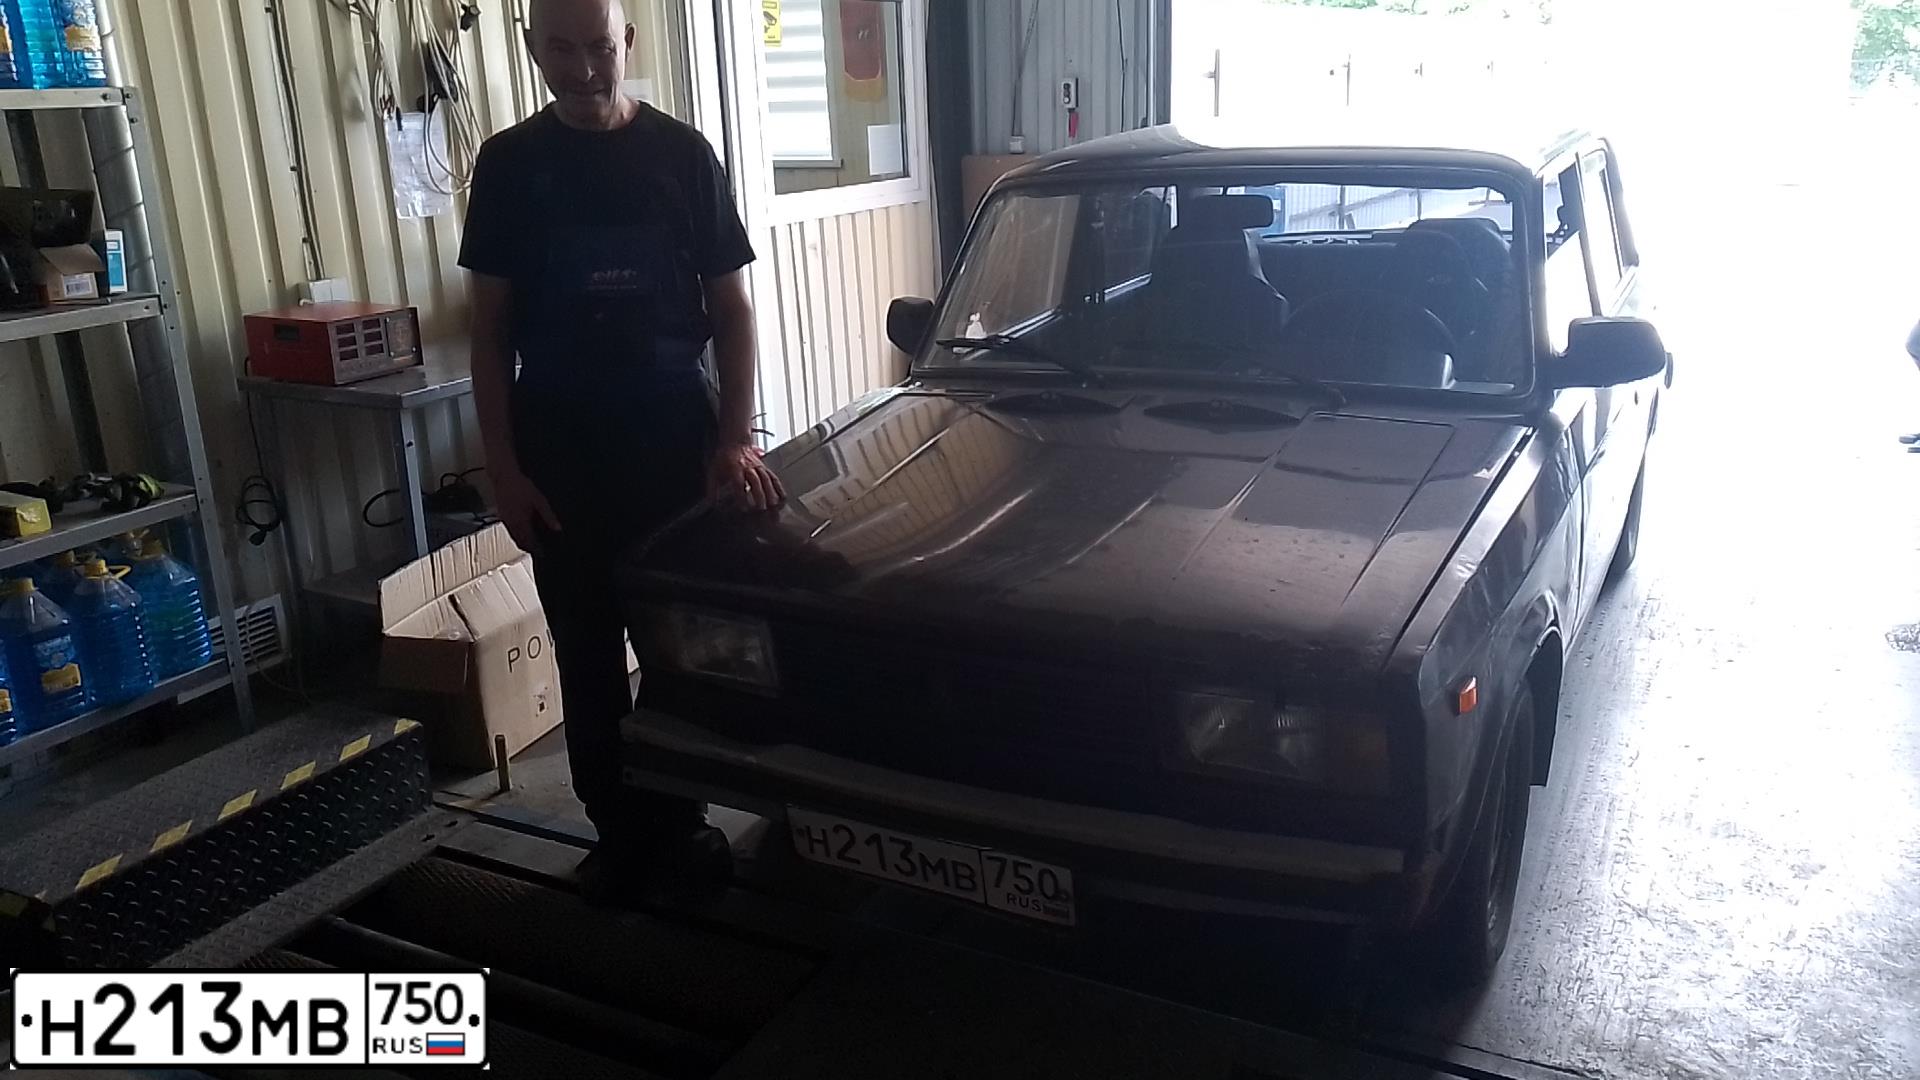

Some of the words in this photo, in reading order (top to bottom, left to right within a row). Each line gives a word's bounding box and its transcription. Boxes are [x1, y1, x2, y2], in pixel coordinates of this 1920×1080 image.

[507, 628, 554, 674] PO
[987, 855, 1059, 900] 750
[1006, 892, 1042, 913] RUS
